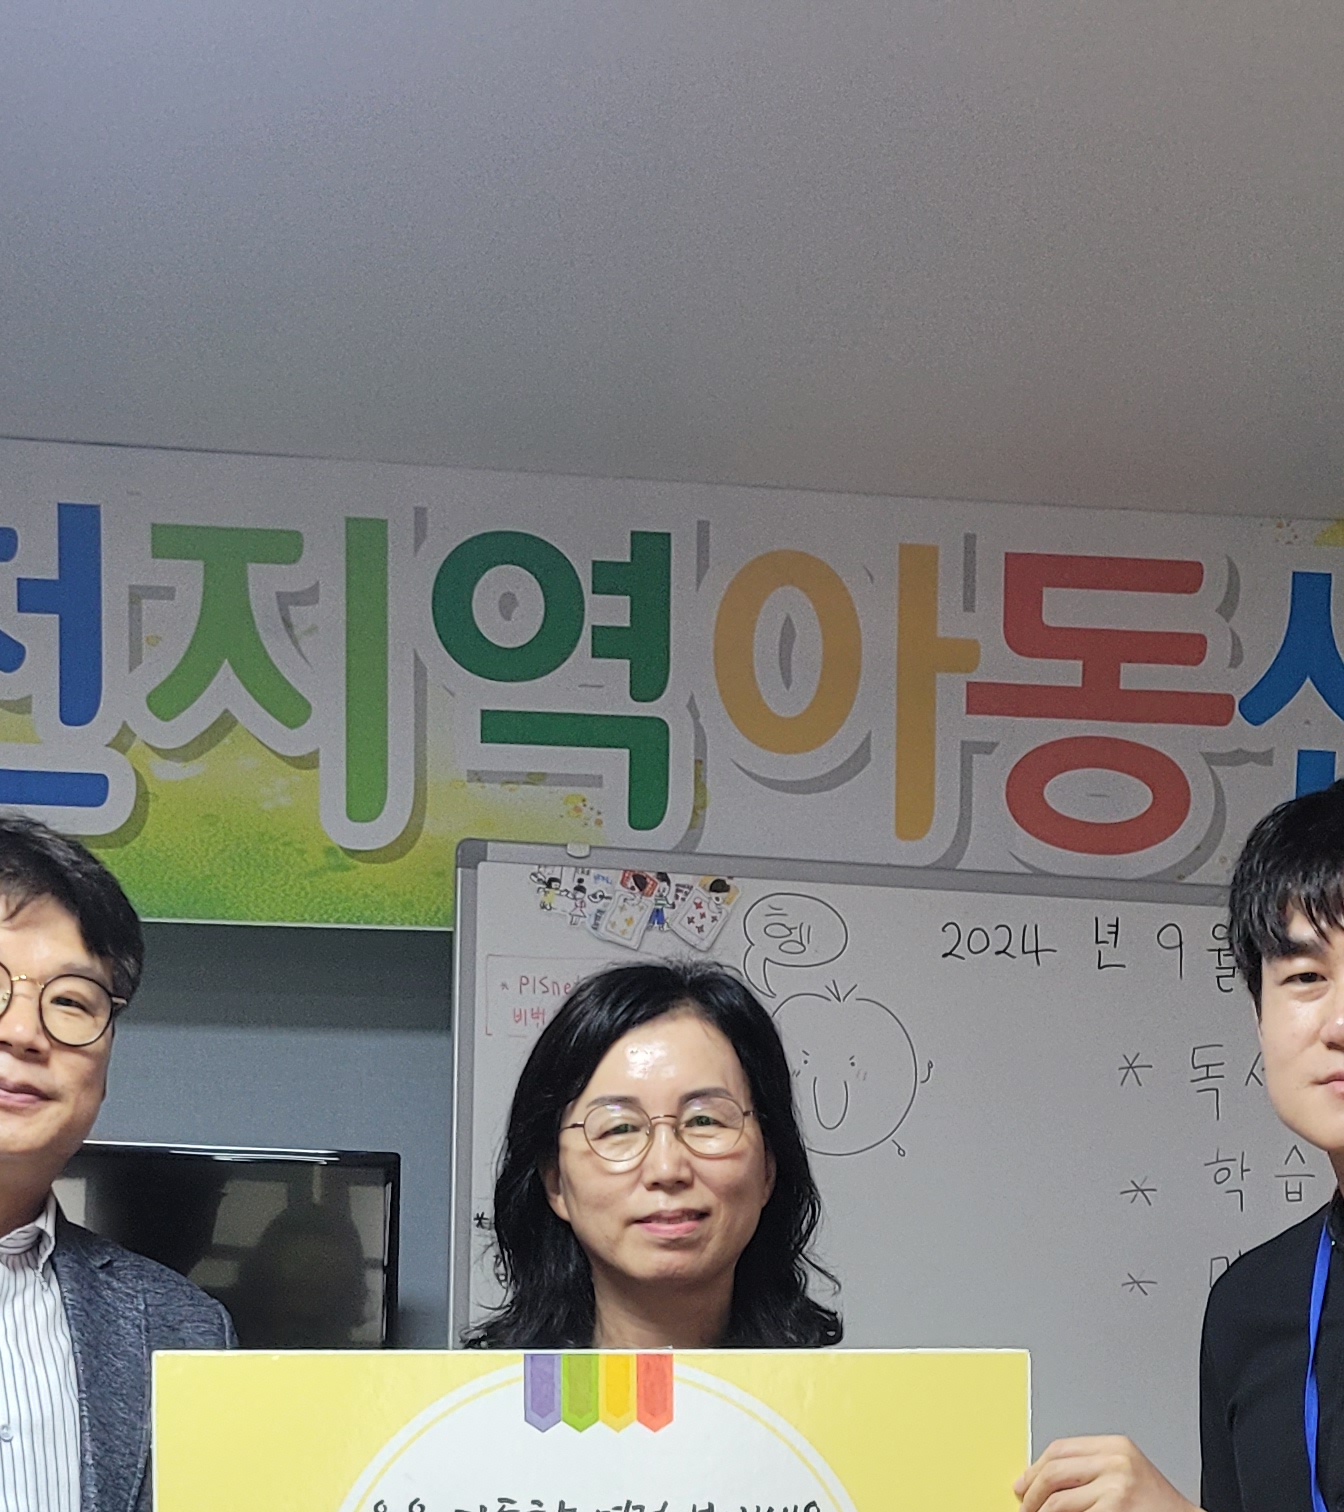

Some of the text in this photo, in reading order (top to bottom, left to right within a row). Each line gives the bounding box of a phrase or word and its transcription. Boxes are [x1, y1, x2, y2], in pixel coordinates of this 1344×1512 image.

[942, 922, 1057, 966] 2024
[1095, 916, 1126, 969] 년
[1157, 923, 1183, 979] 9
[1204, 1145, 1315, 1212] 학습
